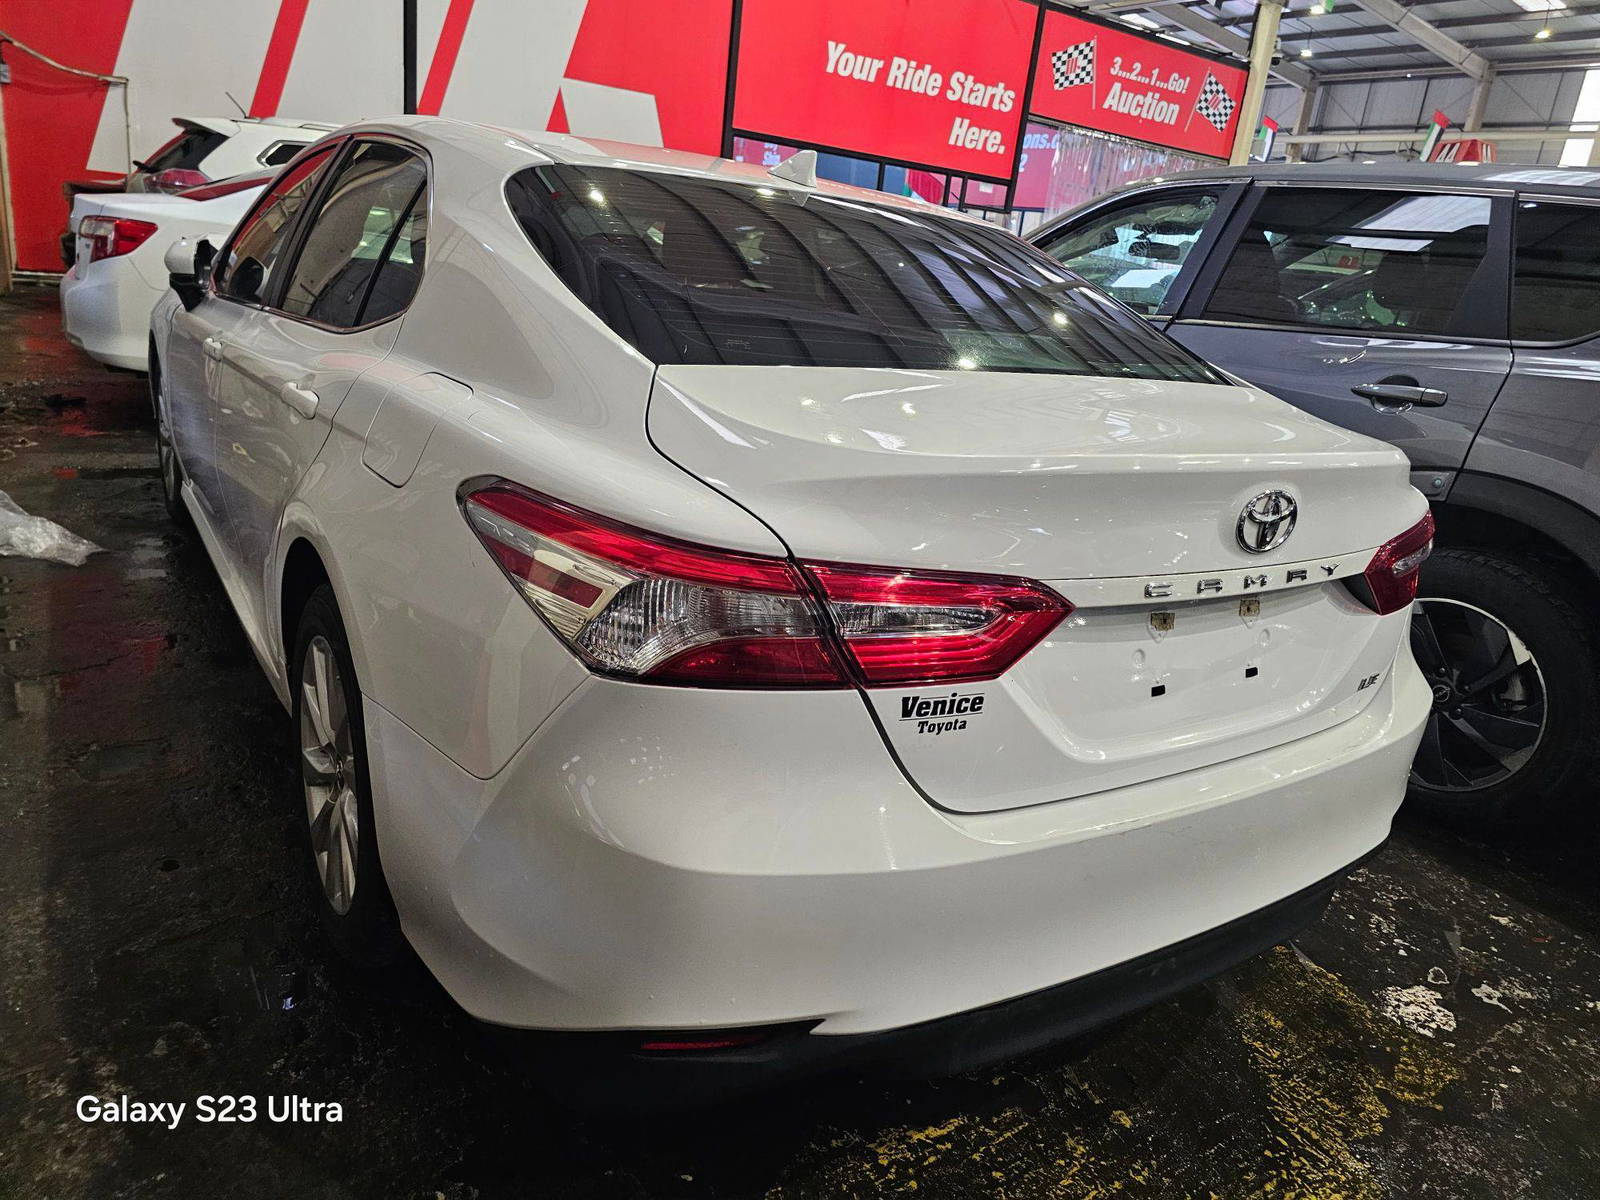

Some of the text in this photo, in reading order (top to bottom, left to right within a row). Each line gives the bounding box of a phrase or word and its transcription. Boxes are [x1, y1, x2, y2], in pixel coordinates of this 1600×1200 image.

[826, 41, 1016, 113] Your Ride Starts
[1102, 82, 1180, 125] Auction
[948, 117, 1006, 154] Here.
[1144, 563, 1341, 599] CAMRY
[901, 692, 985, 718] Venice
[918, 718, 967, 735] Toyota
